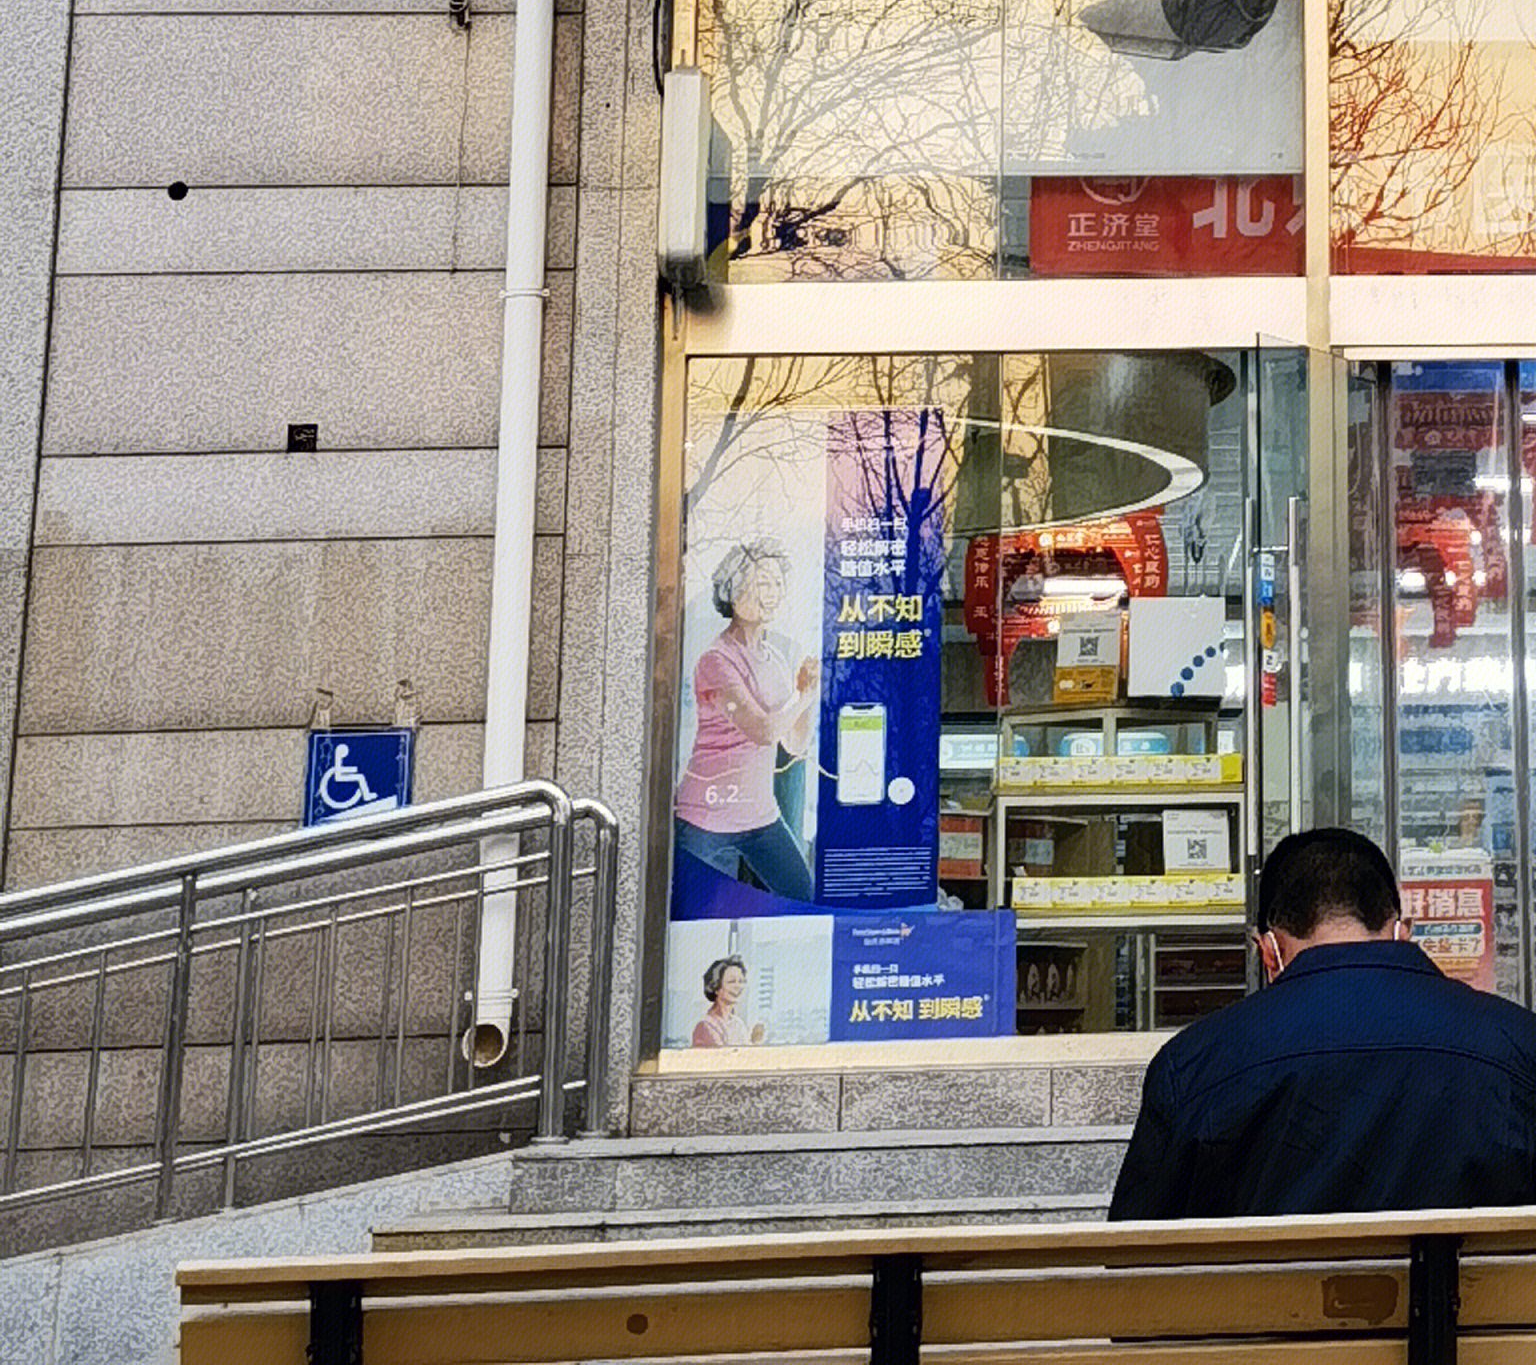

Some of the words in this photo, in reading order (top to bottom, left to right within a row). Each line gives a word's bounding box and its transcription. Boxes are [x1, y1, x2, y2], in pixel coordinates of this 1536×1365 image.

[1067, 212, 1161, 238] 正济堂
[1067, 241, 1161, 253] ZHENGJITANG
[838, 593, 923, 622] 从不知
[837, 628, 923, 660] 到瞬感
[705, 784, 739, 805] 6.2
[849, 998, 914, 1022] 从不知
